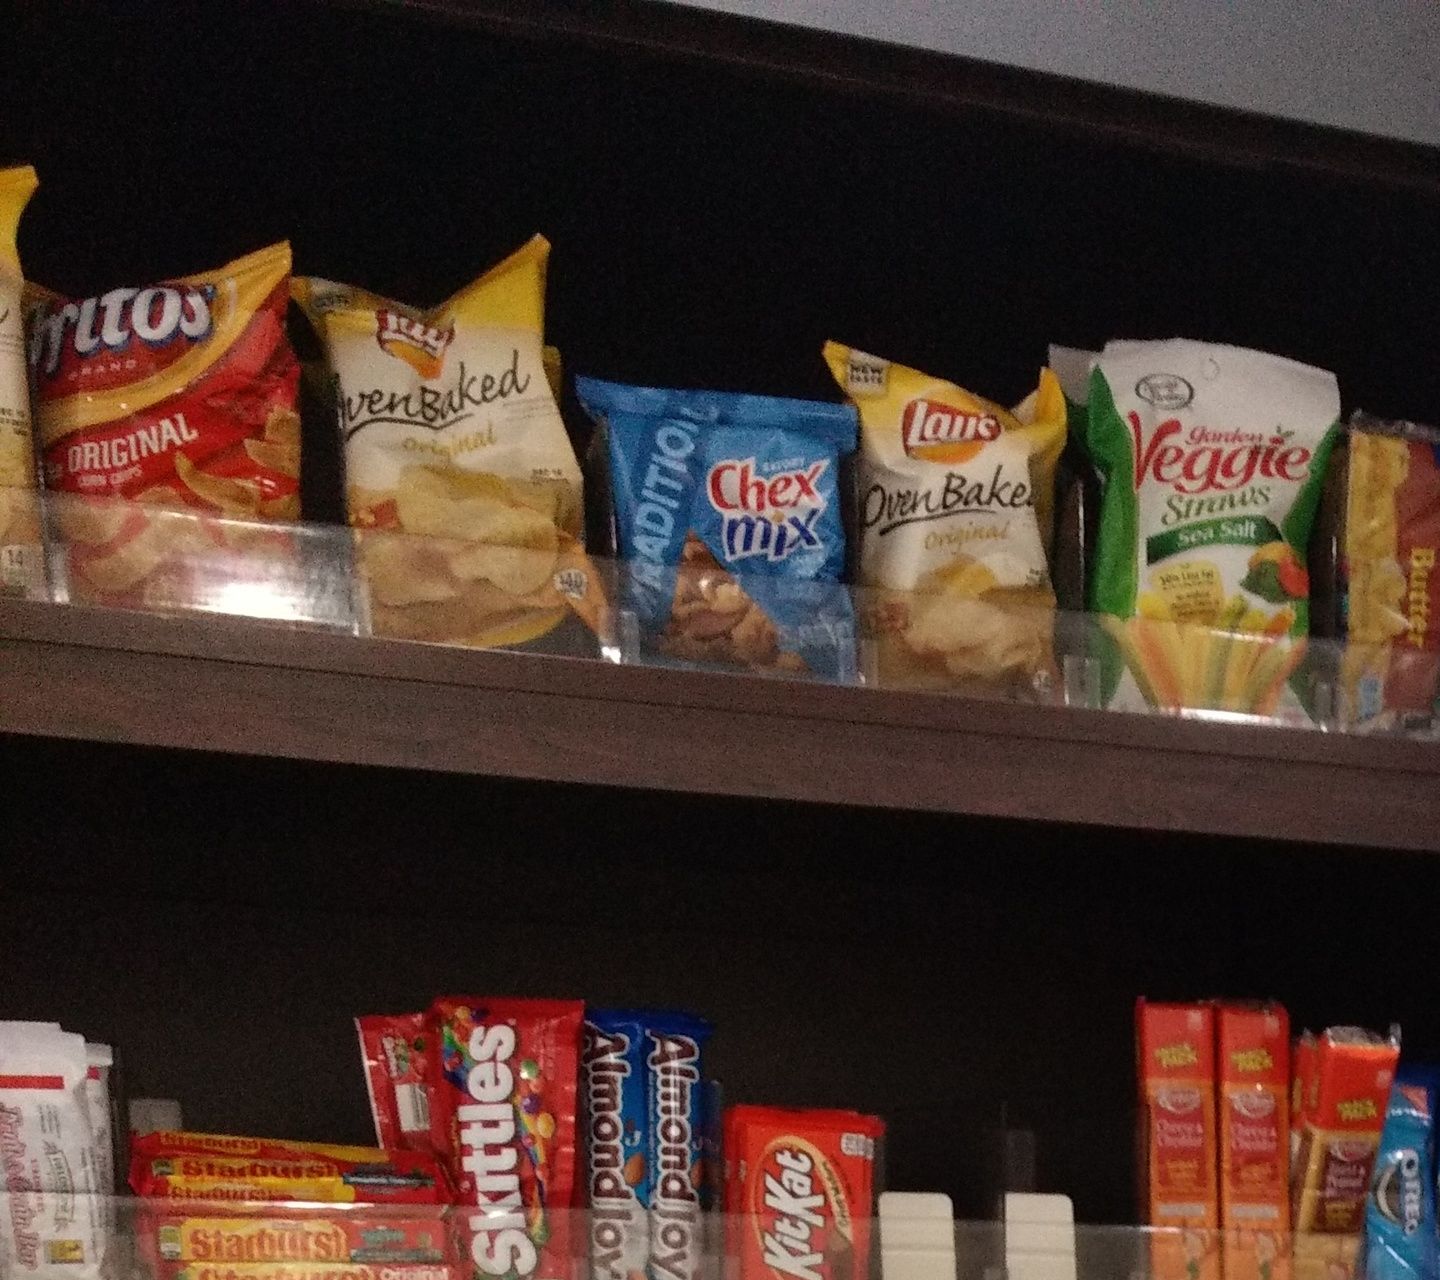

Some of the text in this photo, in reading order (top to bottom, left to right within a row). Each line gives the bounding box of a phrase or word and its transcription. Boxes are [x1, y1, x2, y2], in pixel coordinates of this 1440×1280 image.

[67, 413, 198, 473] ORIGINAL
[1127, 410, 1311, 494] Veggie
[709, 463, 824, 512] Chex
[861, 464, 1034, 528] Oven Bake
[1161, 484, 1272, 526] Straws
[725, 508, 819, 558] mix
[1178, 518, 1258, 549] Sea Salt
[1408, 546, 1436, 649] Butter
[584, 1022, 634, 1201] Almond
[646, 1028, 699, 1201] Almond
[457, 1023, 538, 1277] Skittles
[188, 1226, 348, 1260] Starburst
